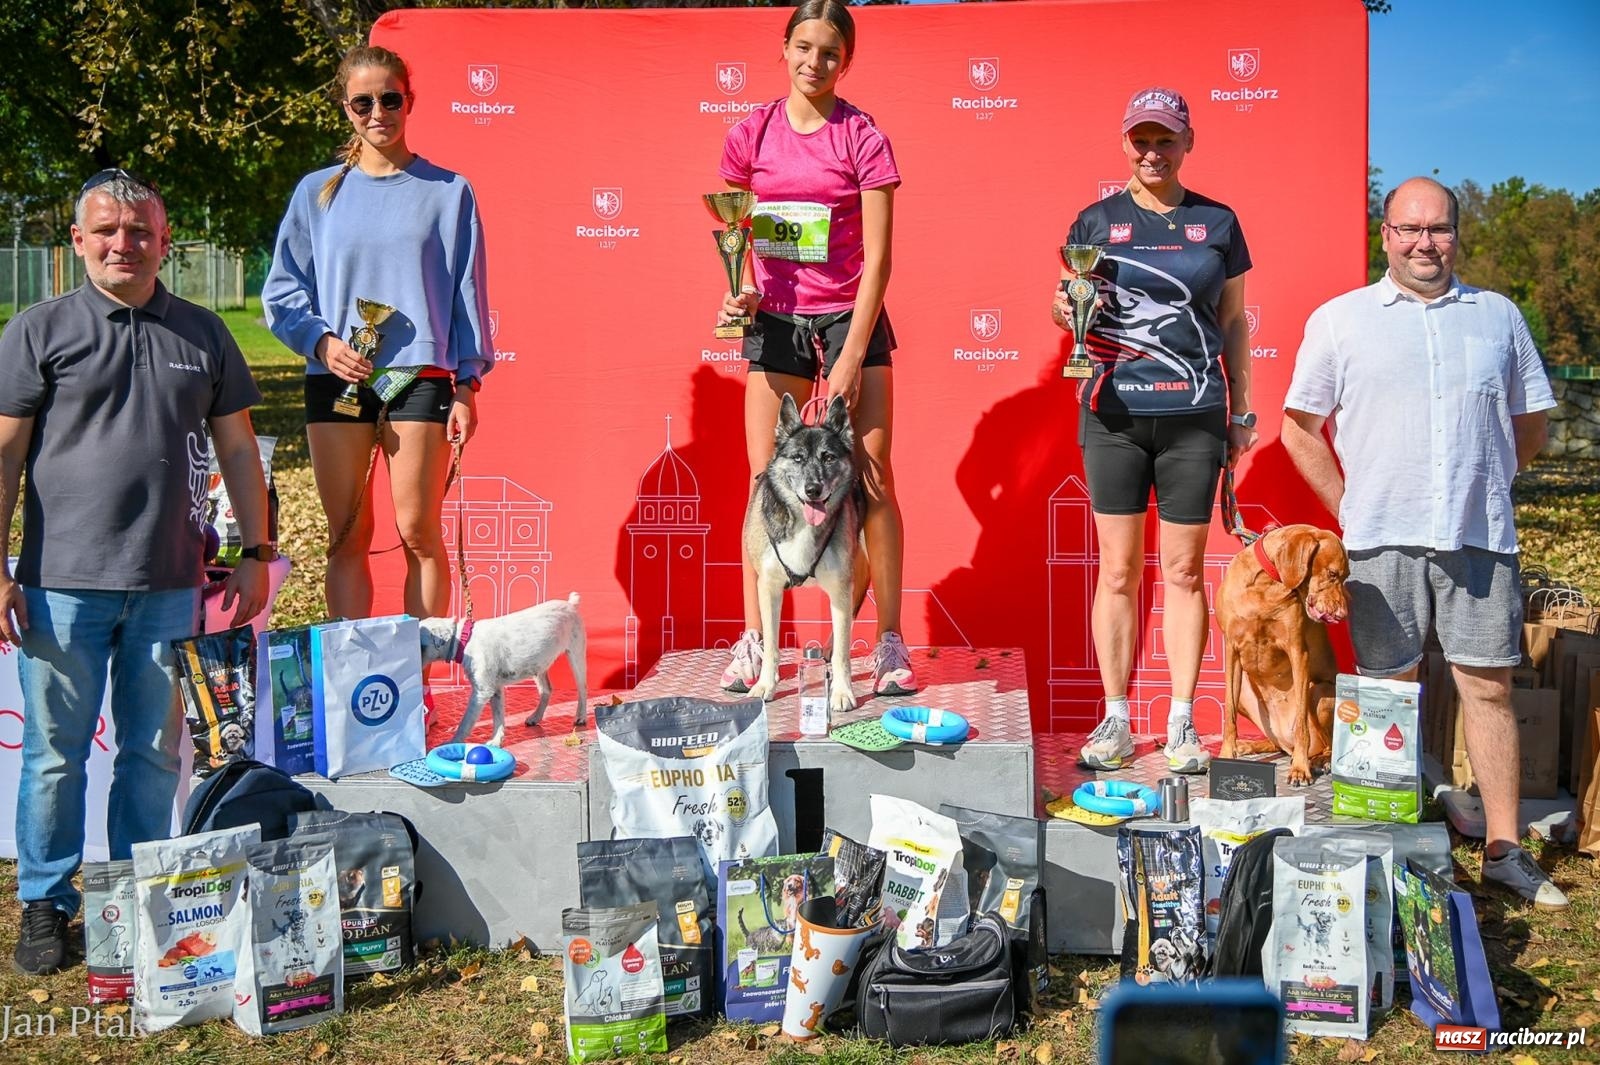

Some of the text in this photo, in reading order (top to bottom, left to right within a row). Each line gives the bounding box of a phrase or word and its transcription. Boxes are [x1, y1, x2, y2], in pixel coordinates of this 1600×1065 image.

[1154, 92, 1179, 110] YORK
[1210, 87, 1279, 102] Racibórz
[451, 101, 515, 115] Racibórz
[700, 101, 763, 113] Racibór
[952, 95, 1018, 110] Racibórz
[1234, 104, 1253, 113] 1217
[473, 118, 491, 126] 1217
[974, 113, 993, 121] 1217
[576, 224, 640, 238] Racibórz
[774, 222, 803, 242] 99
[598, 241, 616, 250] 1217
[702, 349, 742, 361] Racib
[953, 348, 1019, 361] Racibórz
[362, 688, 390, 713] PZU
[651, 731, 719, 747] BIOFEED
[651, 763, 736, 789] EUPHOIA
[672, 793, 718, 816] Fresh
[727, 796, 747, 808] 52%
[893, 850, 936, 875] TropiDog
[1148, 872, 1187, 883] PUFFINS
[171, 880, 233, 898] TropiDog
[887, 879, 926, 904] RABBIT
[1301, 894, 1332, 908] Fresh
[168, 904, 224, 926] SALMON
[362, 943, 382, 952] PUPPY
[604, 1011, 632, 1023] Chicken
